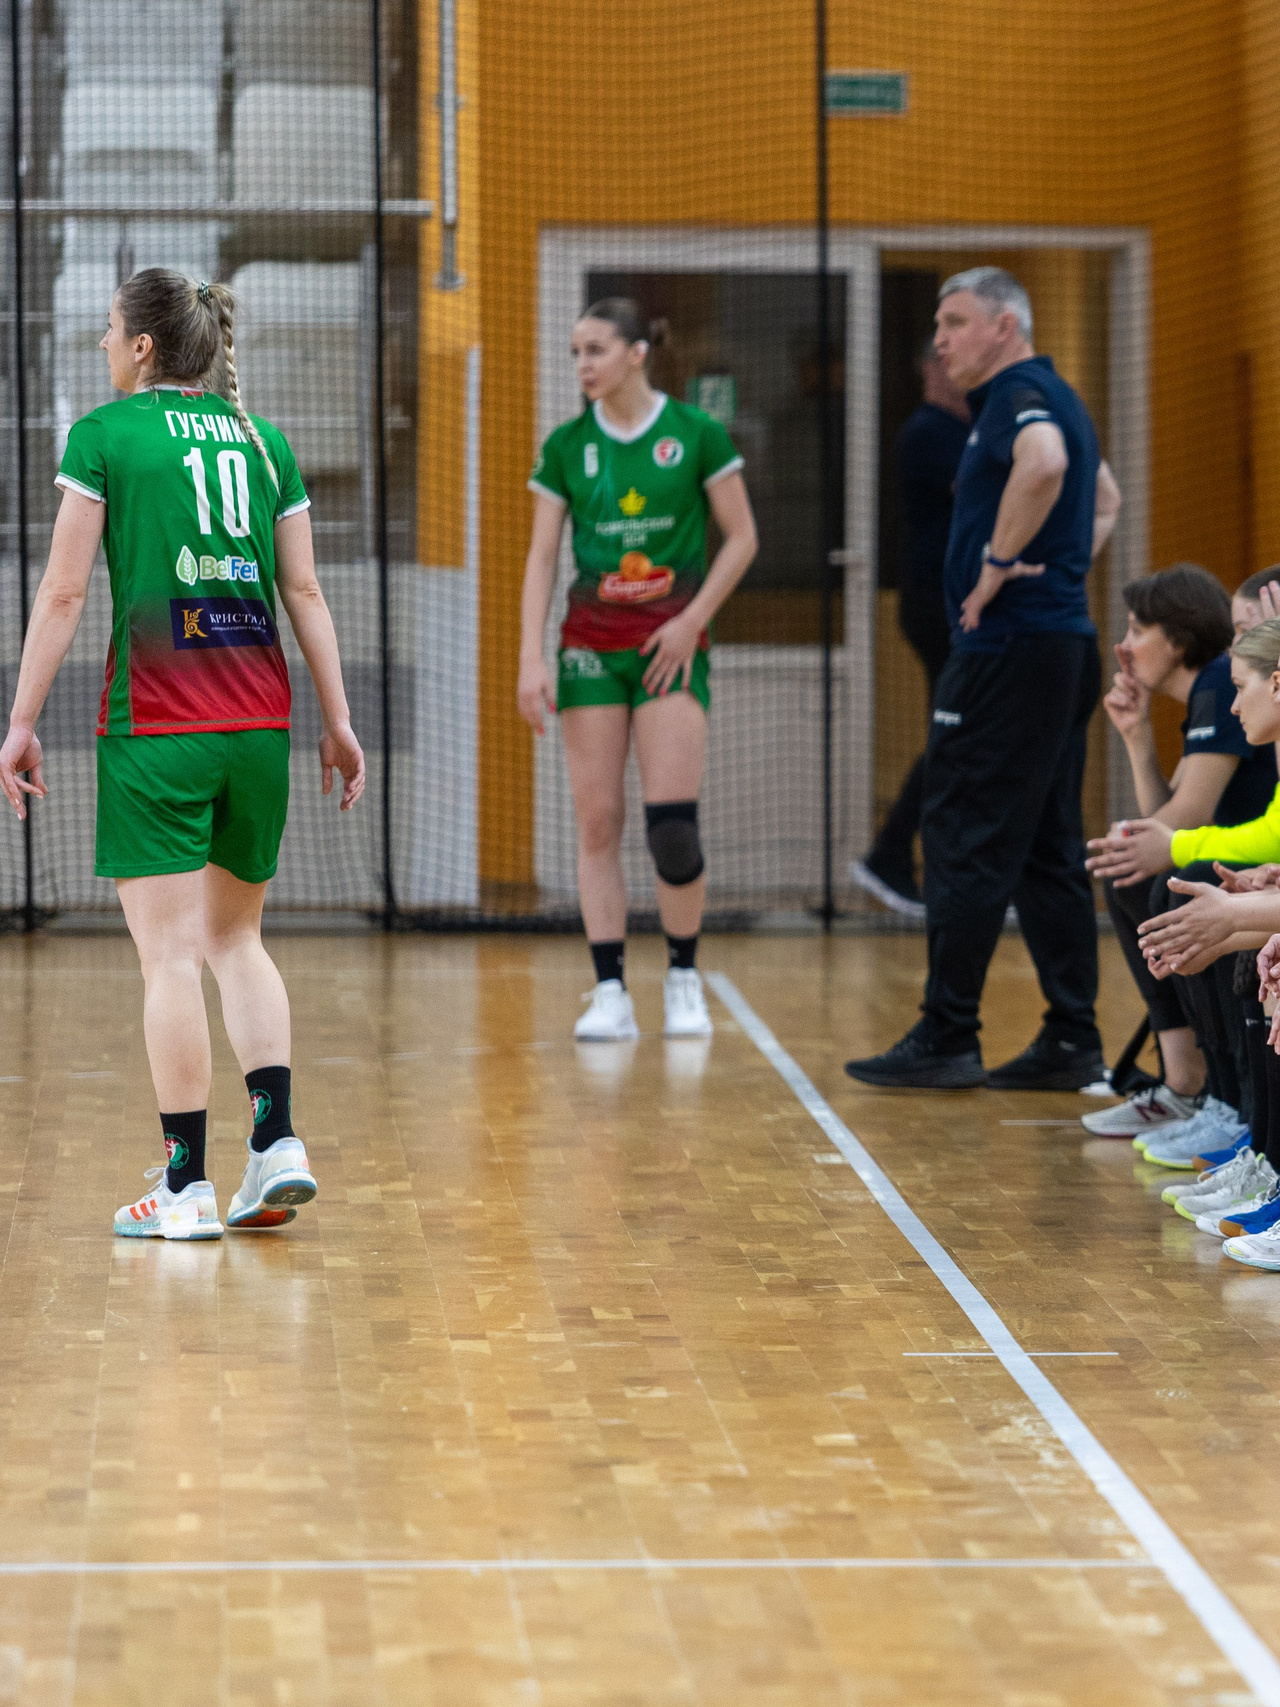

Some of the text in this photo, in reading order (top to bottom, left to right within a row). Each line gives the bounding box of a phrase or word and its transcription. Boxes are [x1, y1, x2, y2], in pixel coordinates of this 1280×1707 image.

[164, 410, 248, 444] ГУБЧИК
[182, 446, 251, 538] 10
[199, 555, 260, 583] BelFer
